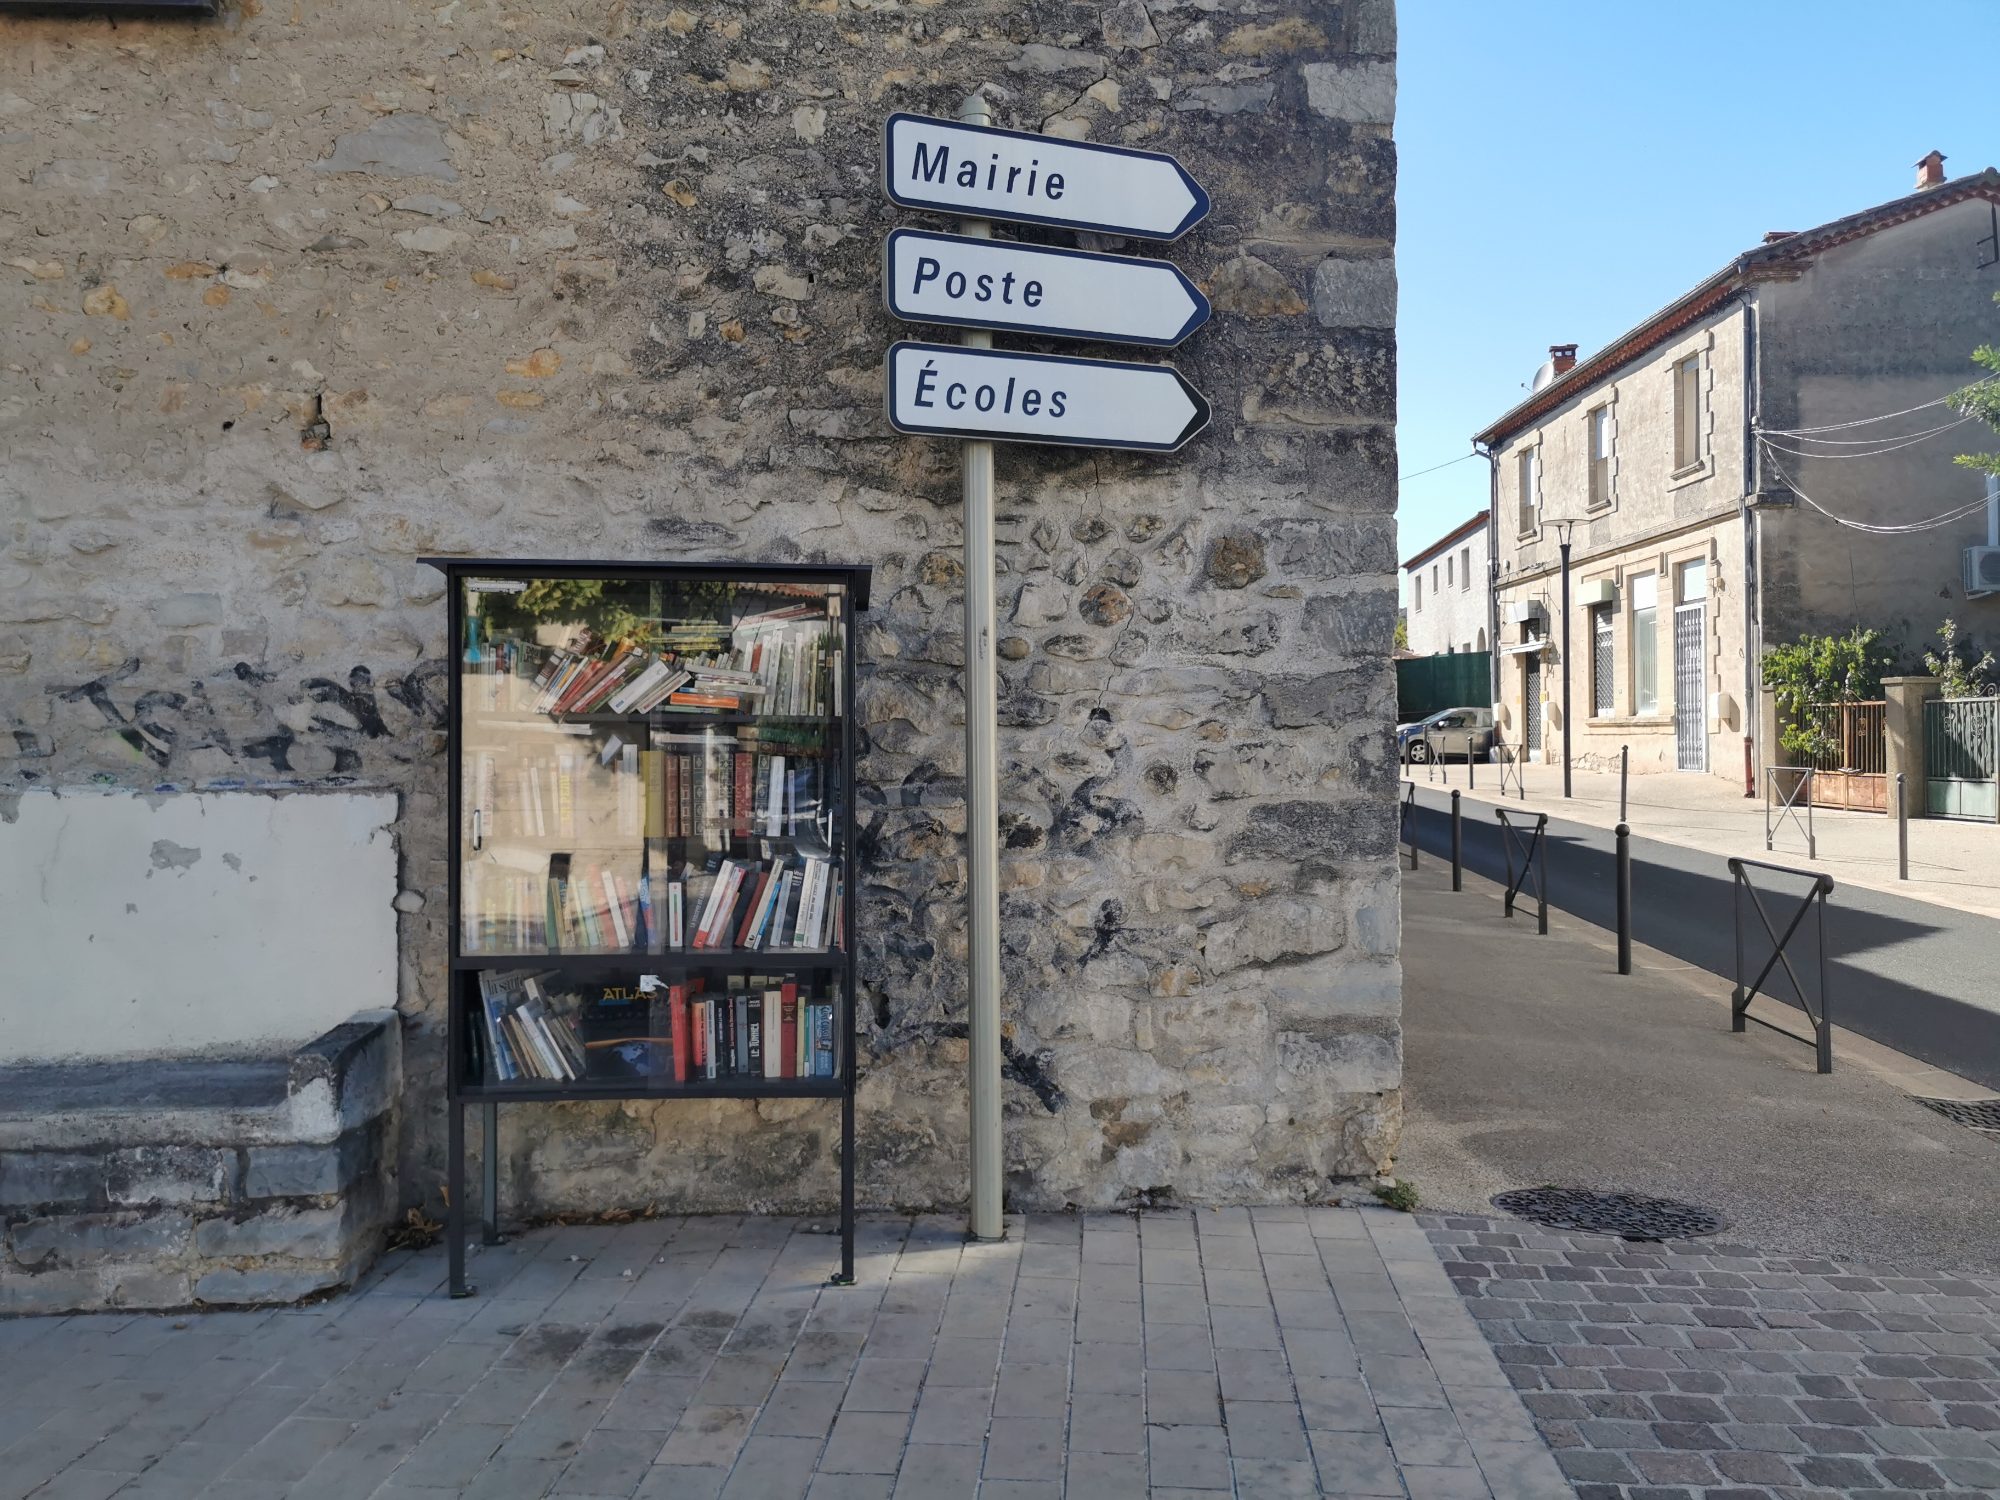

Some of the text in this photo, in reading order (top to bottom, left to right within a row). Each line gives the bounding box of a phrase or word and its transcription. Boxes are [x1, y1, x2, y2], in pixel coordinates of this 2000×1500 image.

[911, 142, 1065, 201] Mairie
[912, 256, 1043, 307] Poste
[913, 359, 1067, 418] Écoles
[603, 985, 658, 1000] ATLAS
